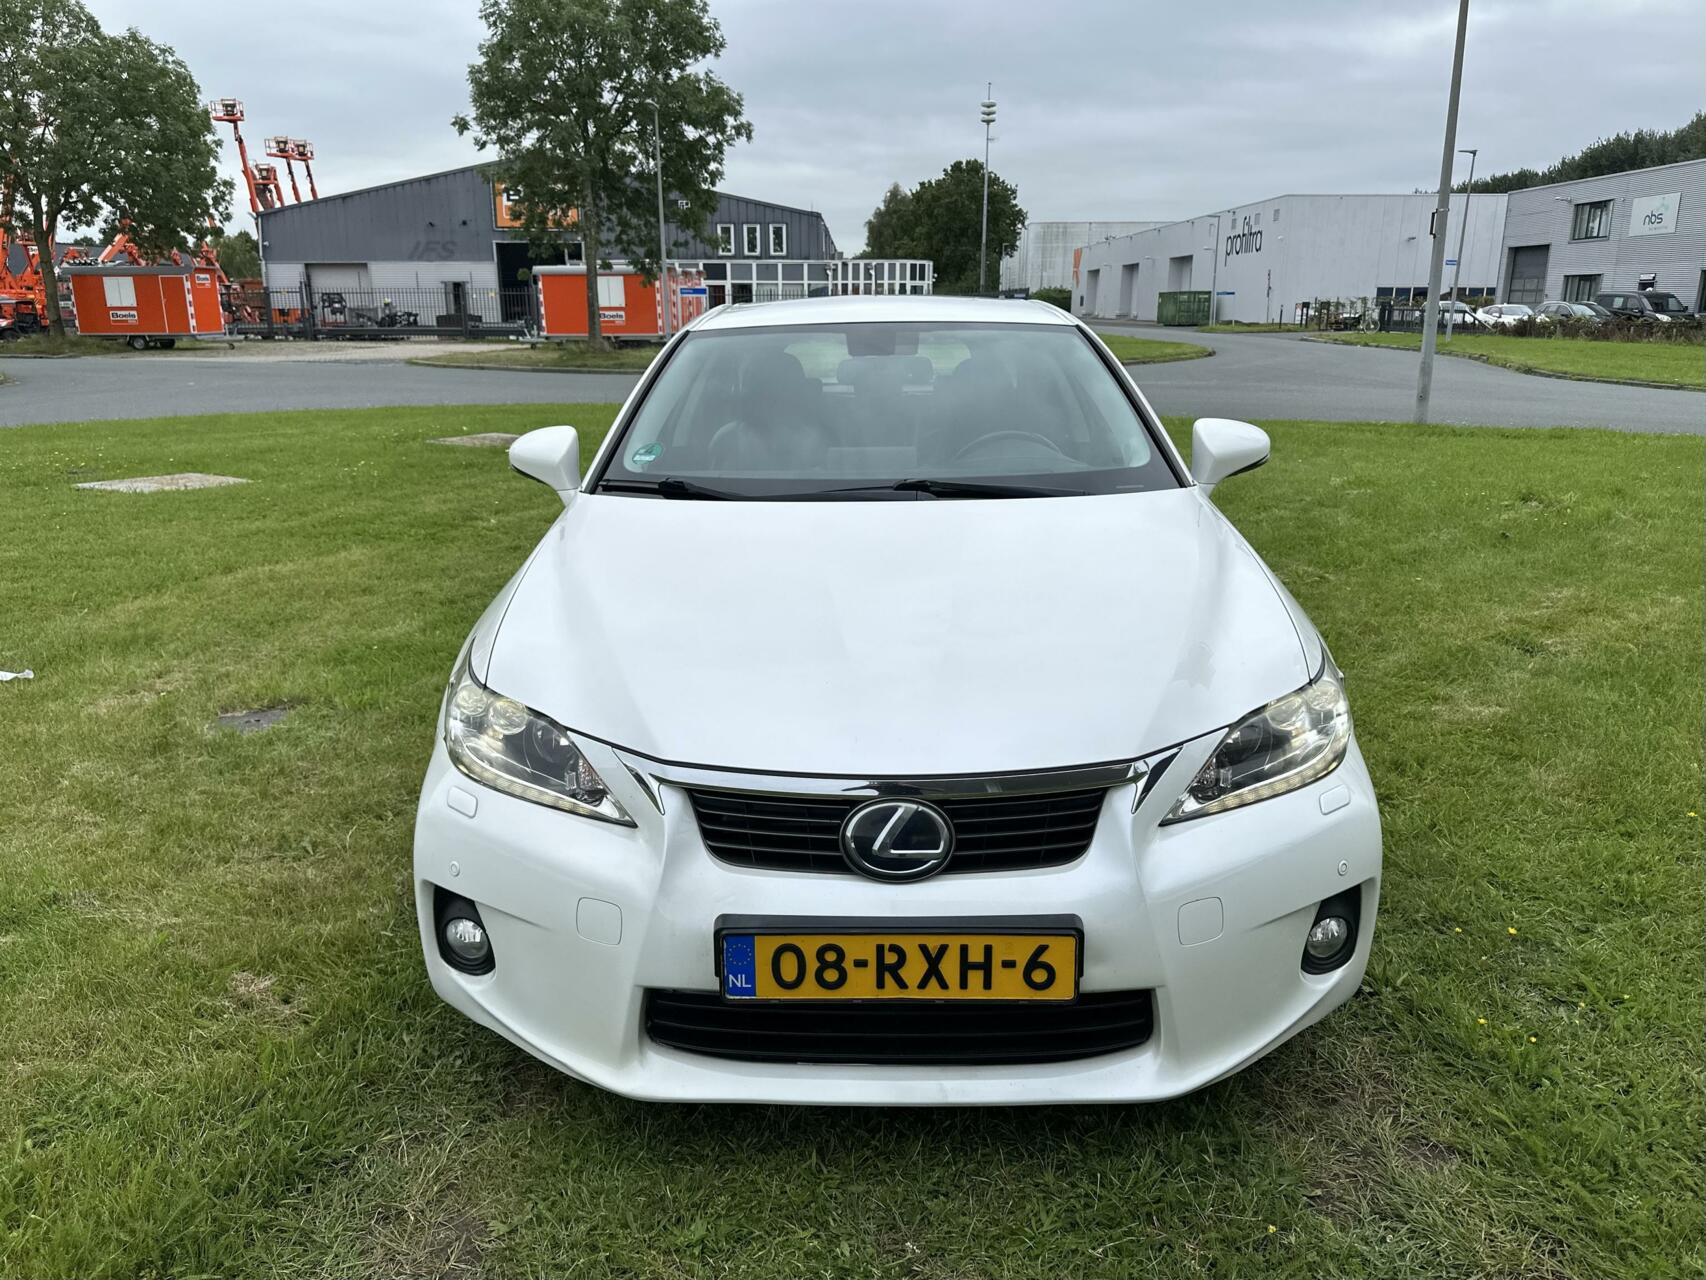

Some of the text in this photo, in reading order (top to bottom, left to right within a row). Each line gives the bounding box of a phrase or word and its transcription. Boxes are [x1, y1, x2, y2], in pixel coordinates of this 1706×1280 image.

[1643, 210, 1664, 226] nbs
[1224, 215, 1262, 267] profiltra
[728, 974, 752, 988] NL
[771, 943, 1056, 991] 08-RXH-6
